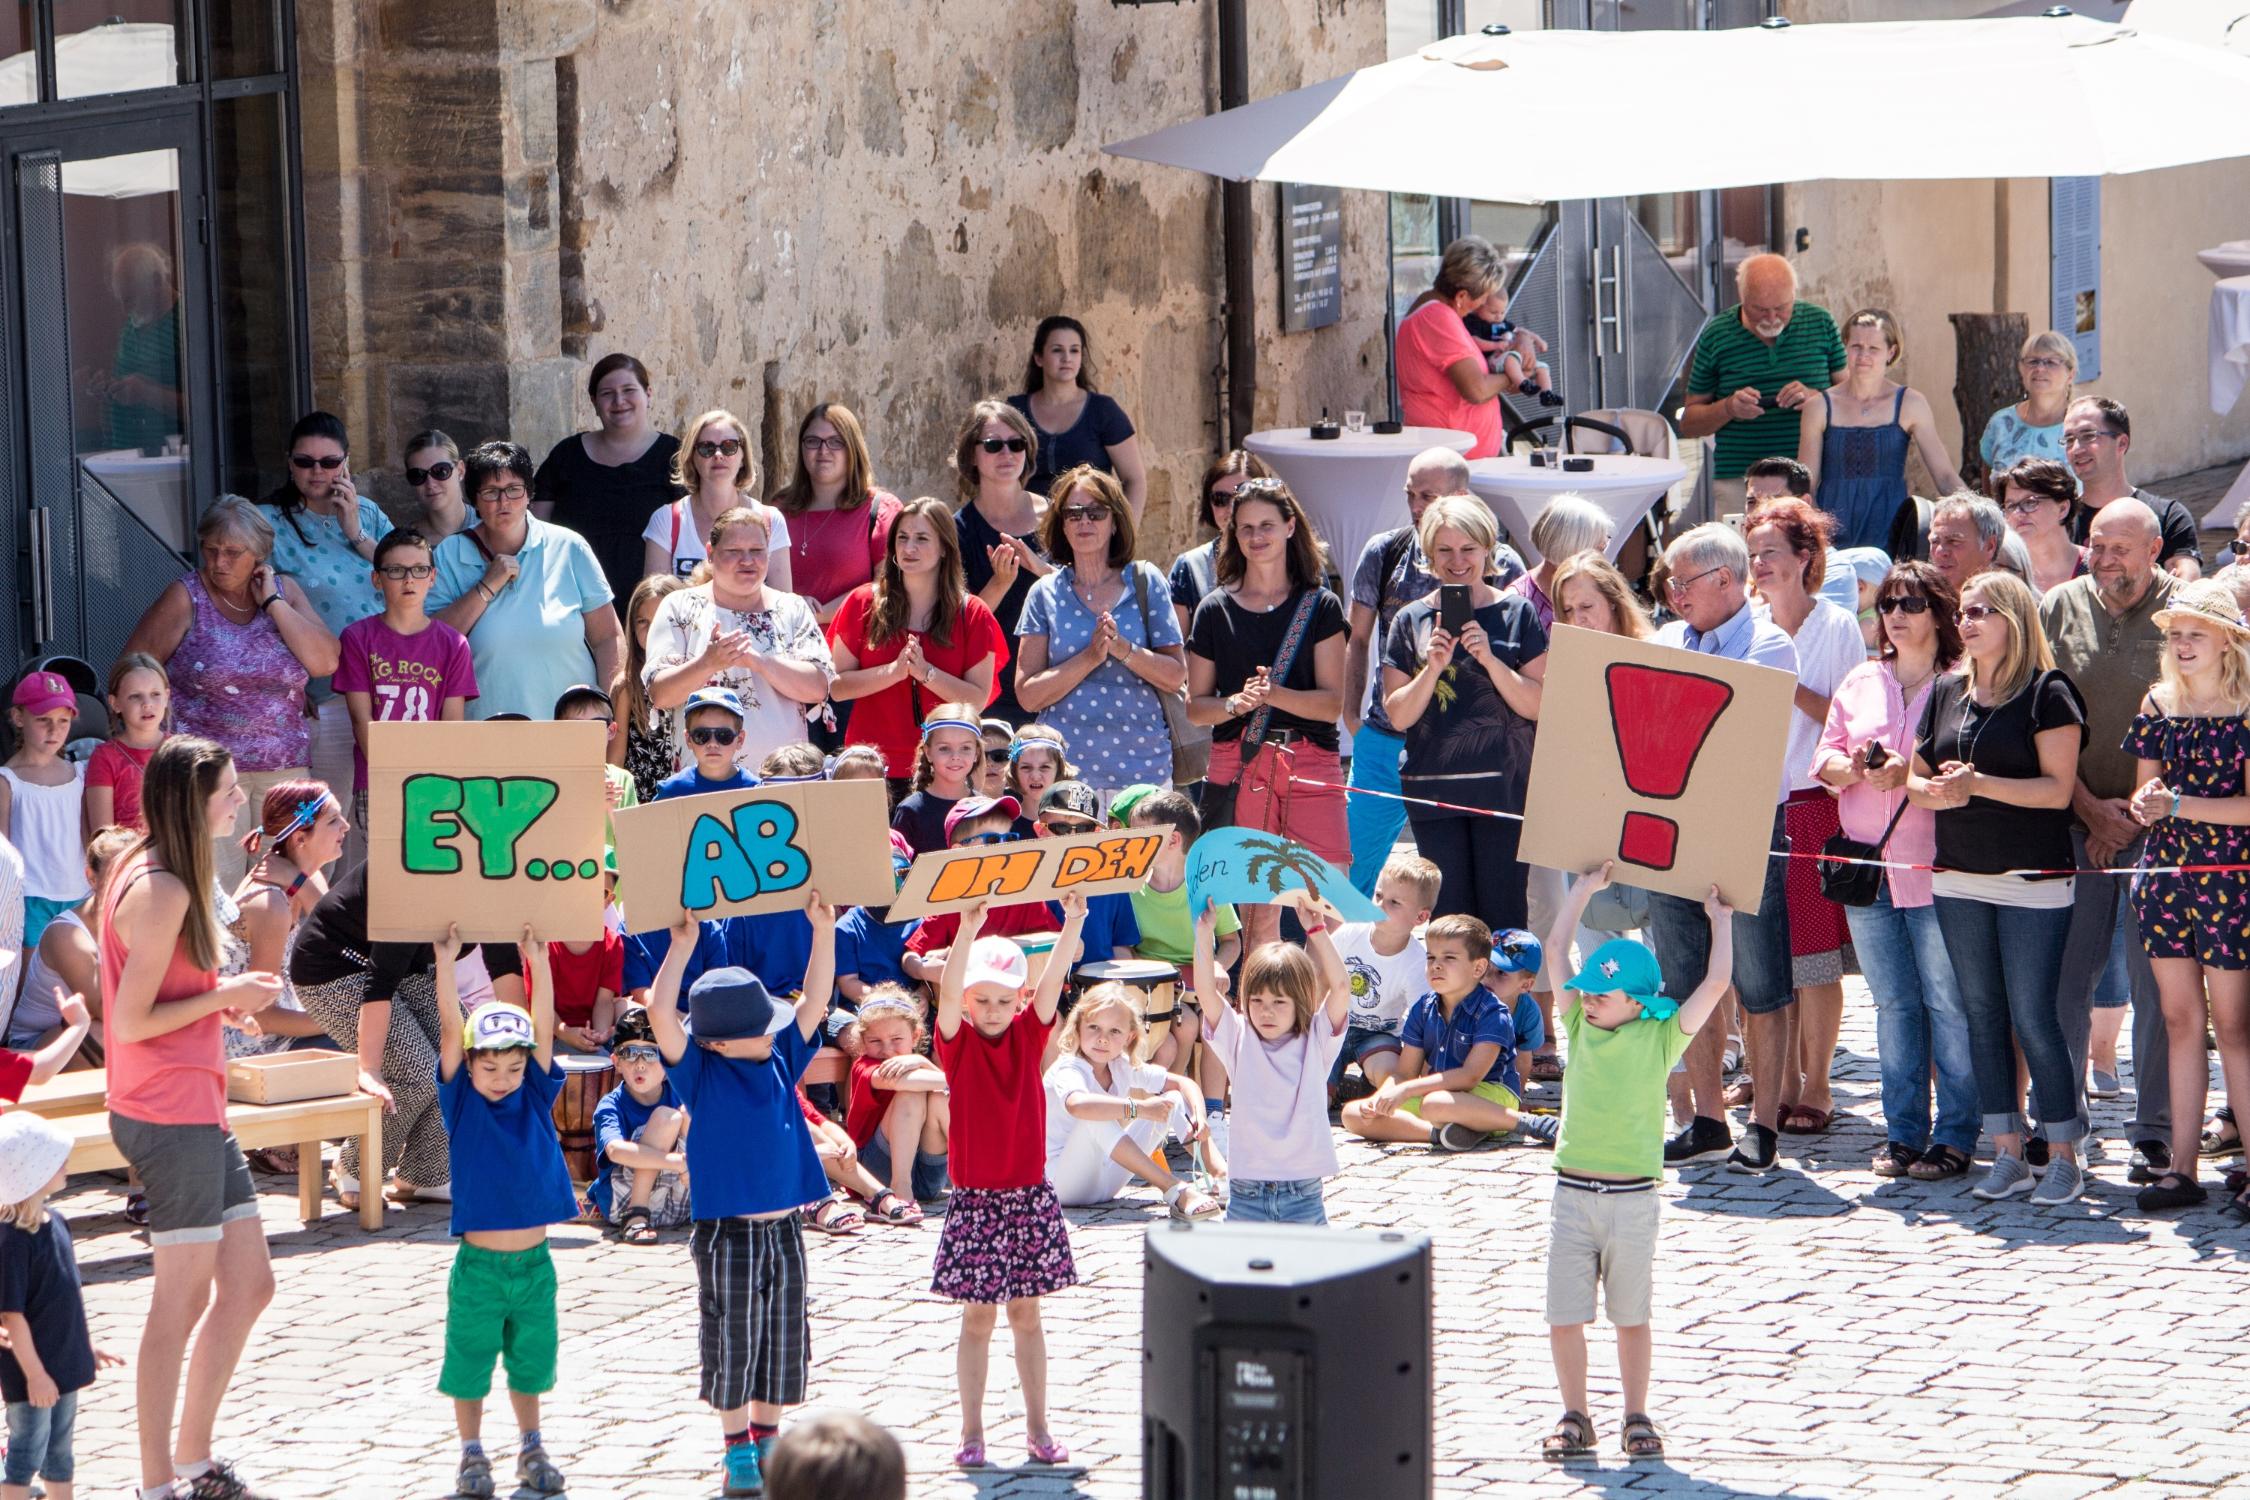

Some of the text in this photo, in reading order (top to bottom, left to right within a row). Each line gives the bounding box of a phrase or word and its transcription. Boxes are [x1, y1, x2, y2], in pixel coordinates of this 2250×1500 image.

[398, 660, 443, 688] ROCK
[375, 684, 429, 722] 78
[401, 773, 599, 881] EY...
[680, 799, 812, 910] AB
[1051, 835, 1164, 888] DEN
